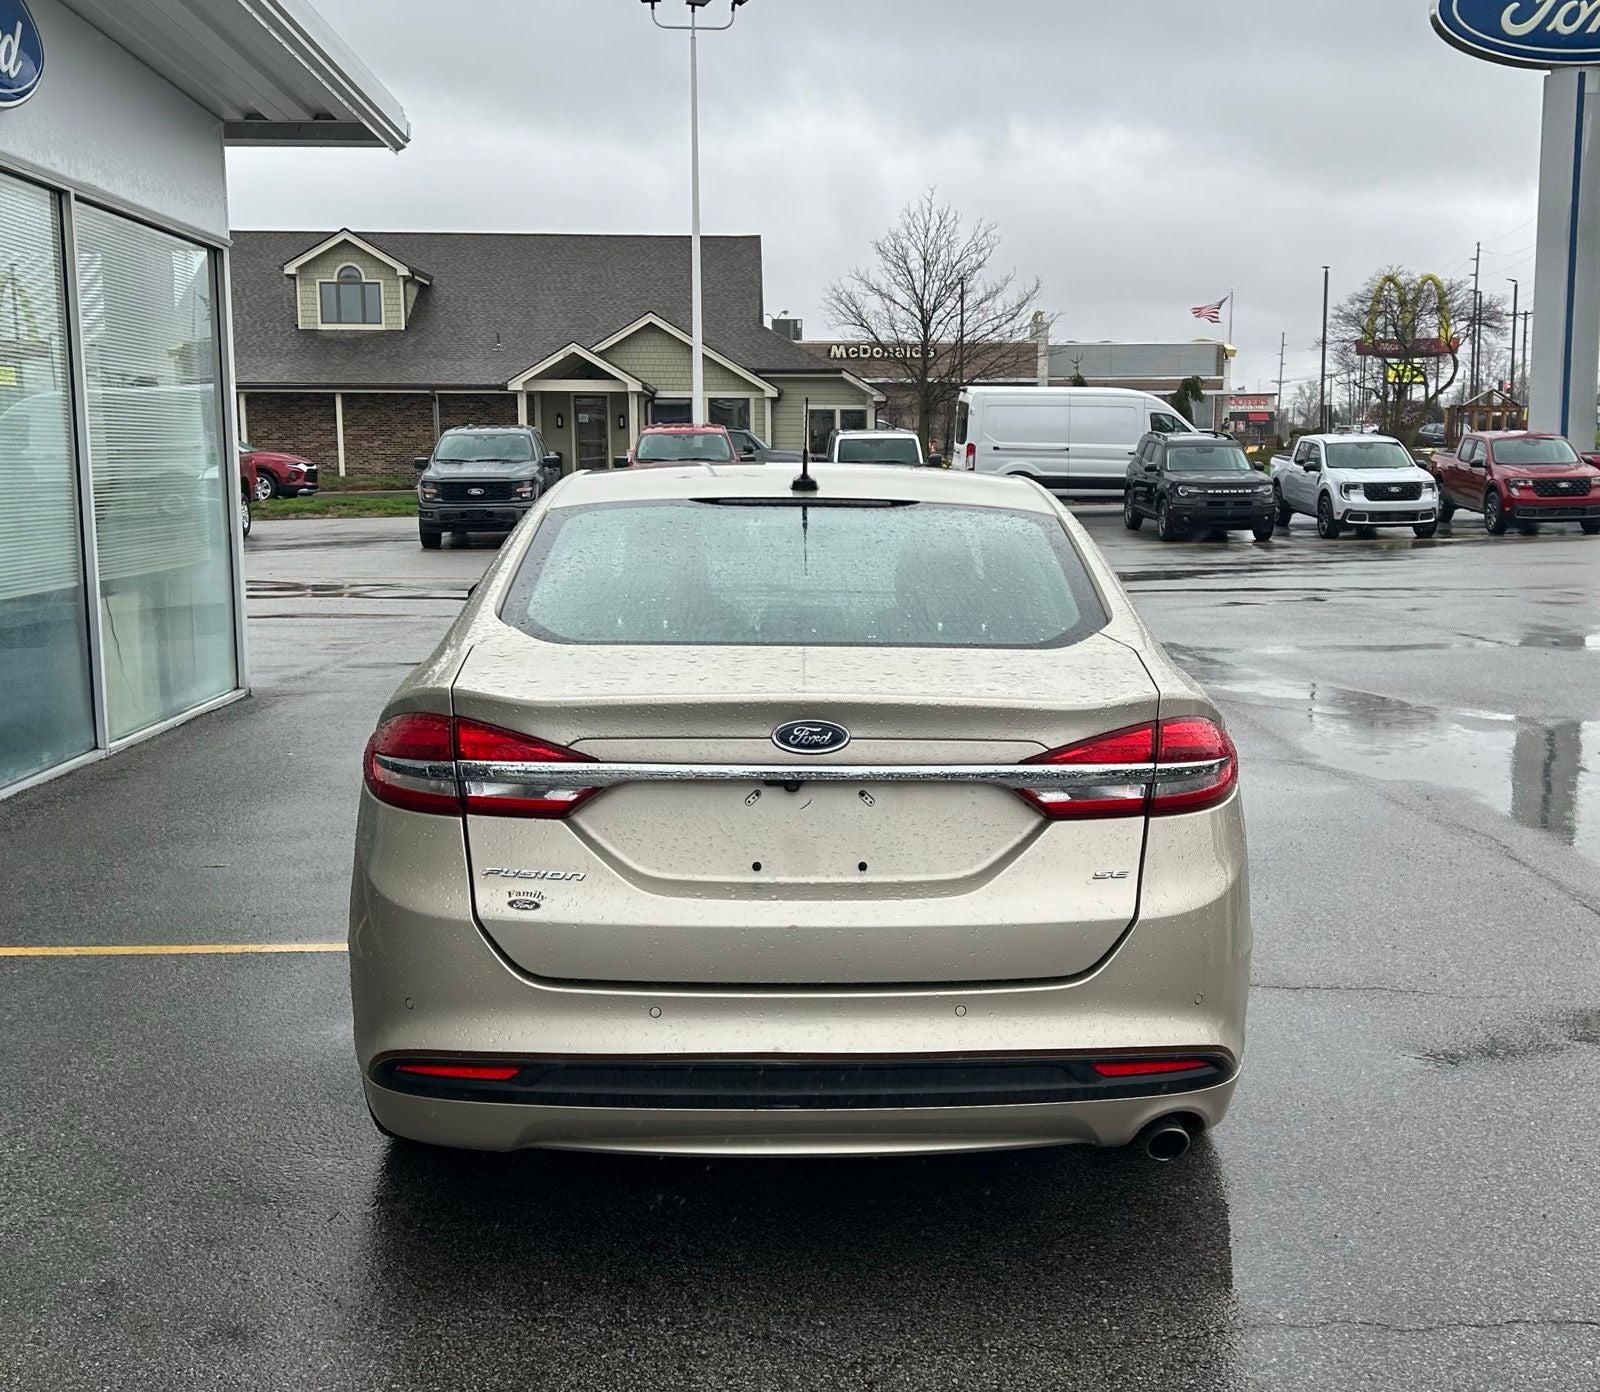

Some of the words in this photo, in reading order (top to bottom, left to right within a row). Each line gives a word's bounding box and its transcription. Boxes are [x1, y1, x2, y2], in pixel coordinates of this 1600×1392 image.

[1500, 0, 1600, 36] Fo
[830, 345, 935, 358] McDonalds
[789, 726, 832, 744] Ford
[481, 867, 586, 881] FUSION
[1092, 870, 1129, 880] SE
[507, 889, 547, 902] Family
[512, 900, 536, 910] Ford
